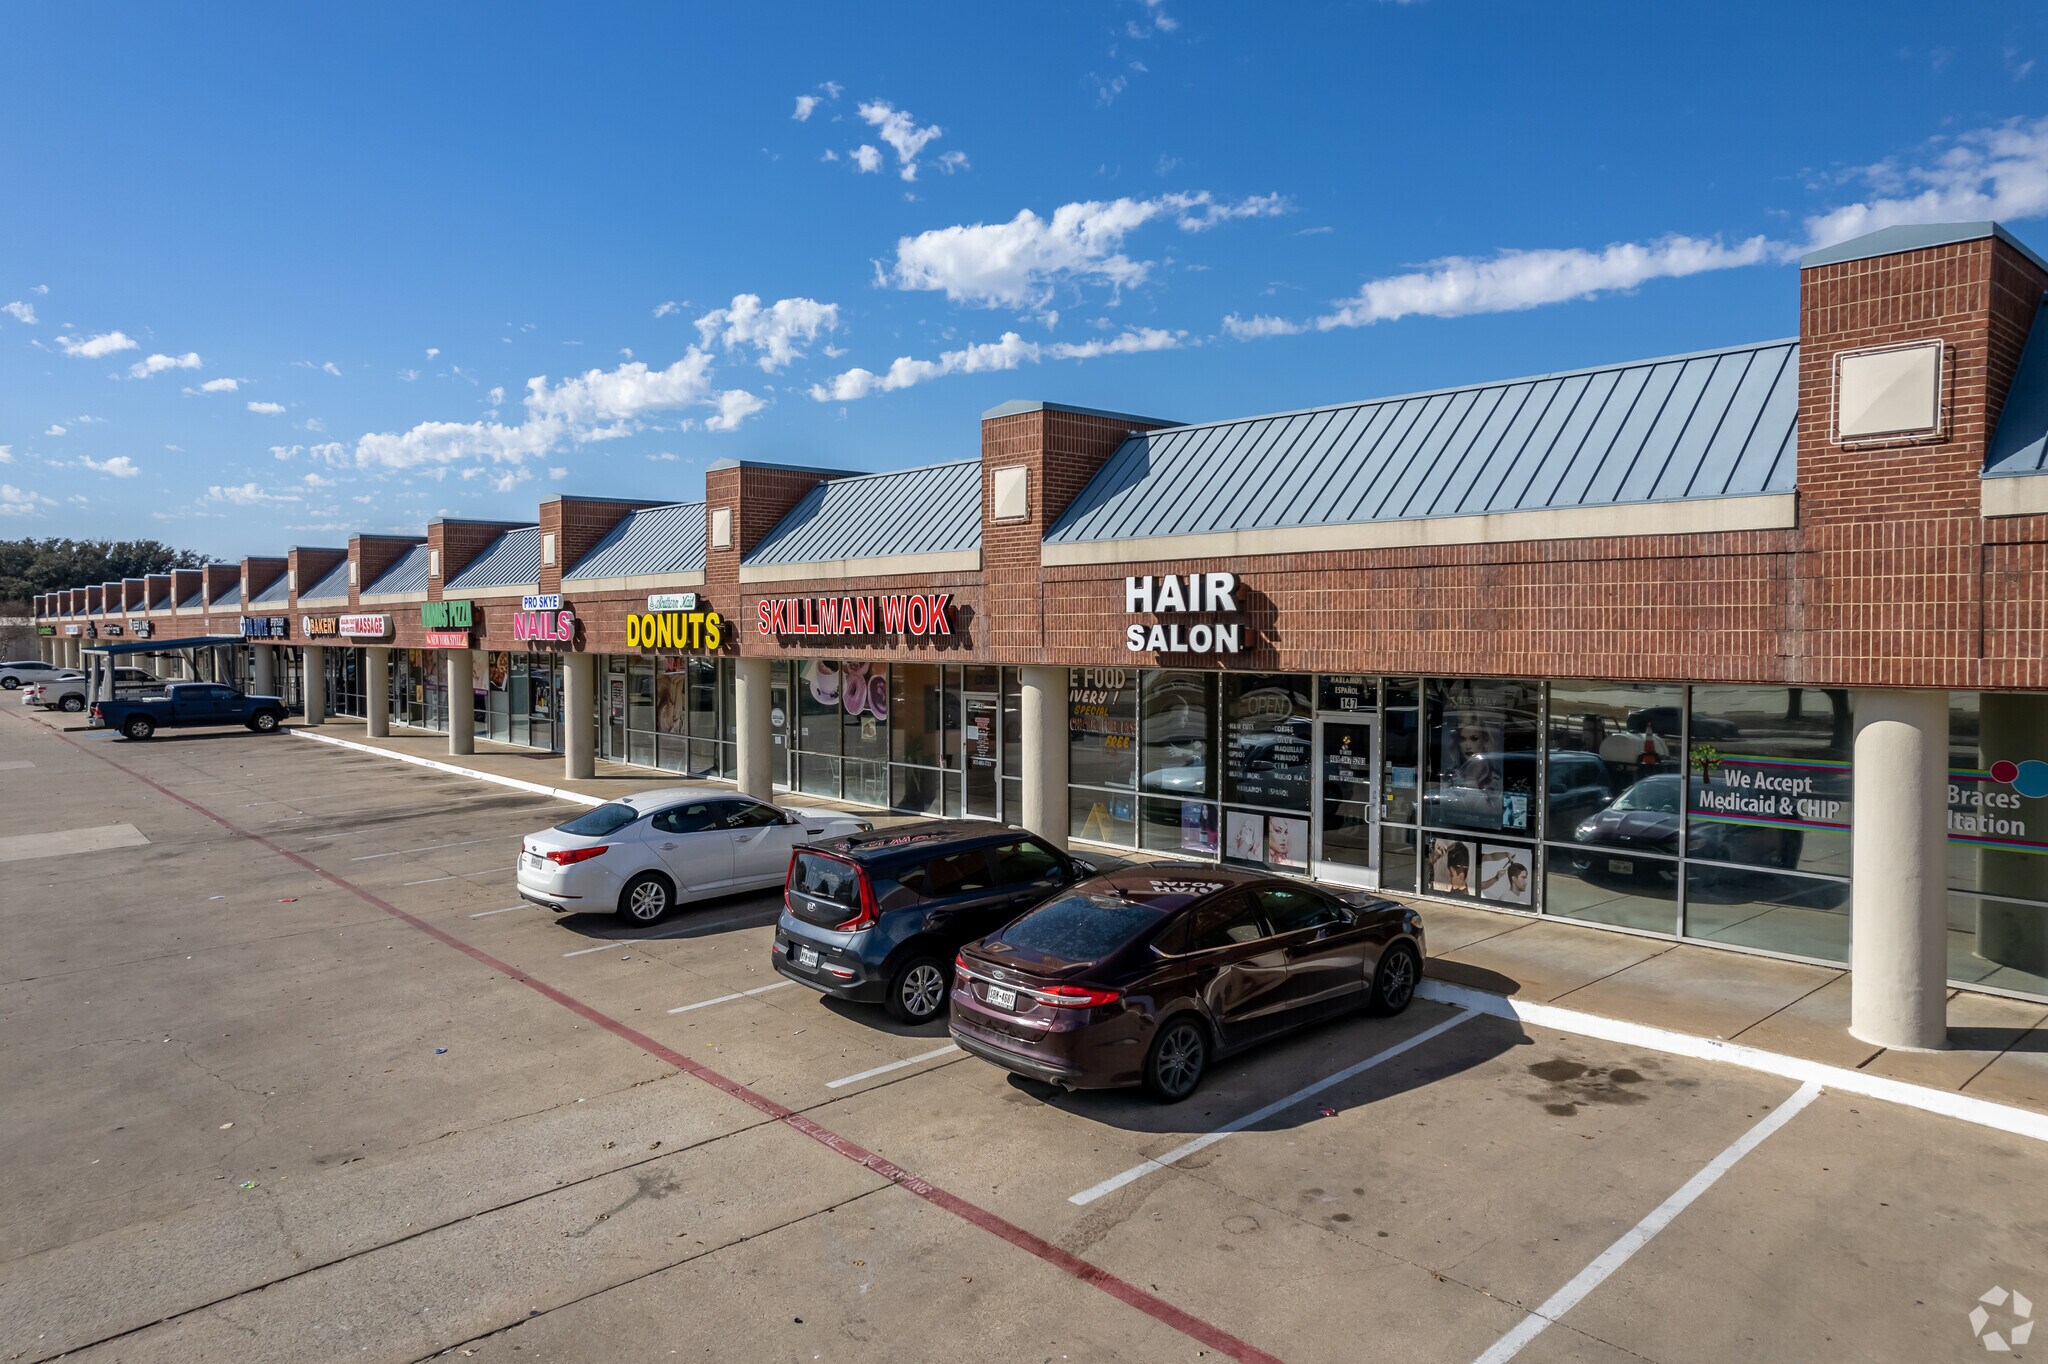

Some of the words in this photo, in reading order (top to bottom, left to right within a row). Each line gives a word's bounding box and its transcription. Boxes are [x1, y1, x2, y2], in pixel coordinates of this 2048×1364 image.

[523, 597, 537, 608] PRO
[539, 596, 558, 608] SKYE
[1125, 572, 1237, 613] HAIR
[310, 618, 336, 634] BAKERY
[354, 617, 383, 634] MASSAGE
[448, 600, 473, 628] PIZZA
[513, 611, 571, 642] NAILS
[757, 596, 875, 636] SKILLMAN
[881, 594, 951, 636] WOK
[627, 612, 720, 650] DONUTS
[1126, 624, 1238, 653] SALON
[1084, 667, 1126, 689] FOOD
[1069, 689, 1108, 705] IVERY
[1247, 696, 1285, 716] OPEN
[1341, 698, 1357, 710] 147
[1073, 705, 1109, 717] SPECIAL
[1105, 735, 1130, 749] FREE
[1724, 769, 1750, 788] We
[1754, 771, 1813, 797] Accept
[1699, 790, 1775, 814] Medicaid
[1778, 797, 1794, 815] &
[1797, 798, 1841, 819] CHIP
[1947, 784, 2021, 809] Braces
[1947, 810, 2025, 837] ltation
